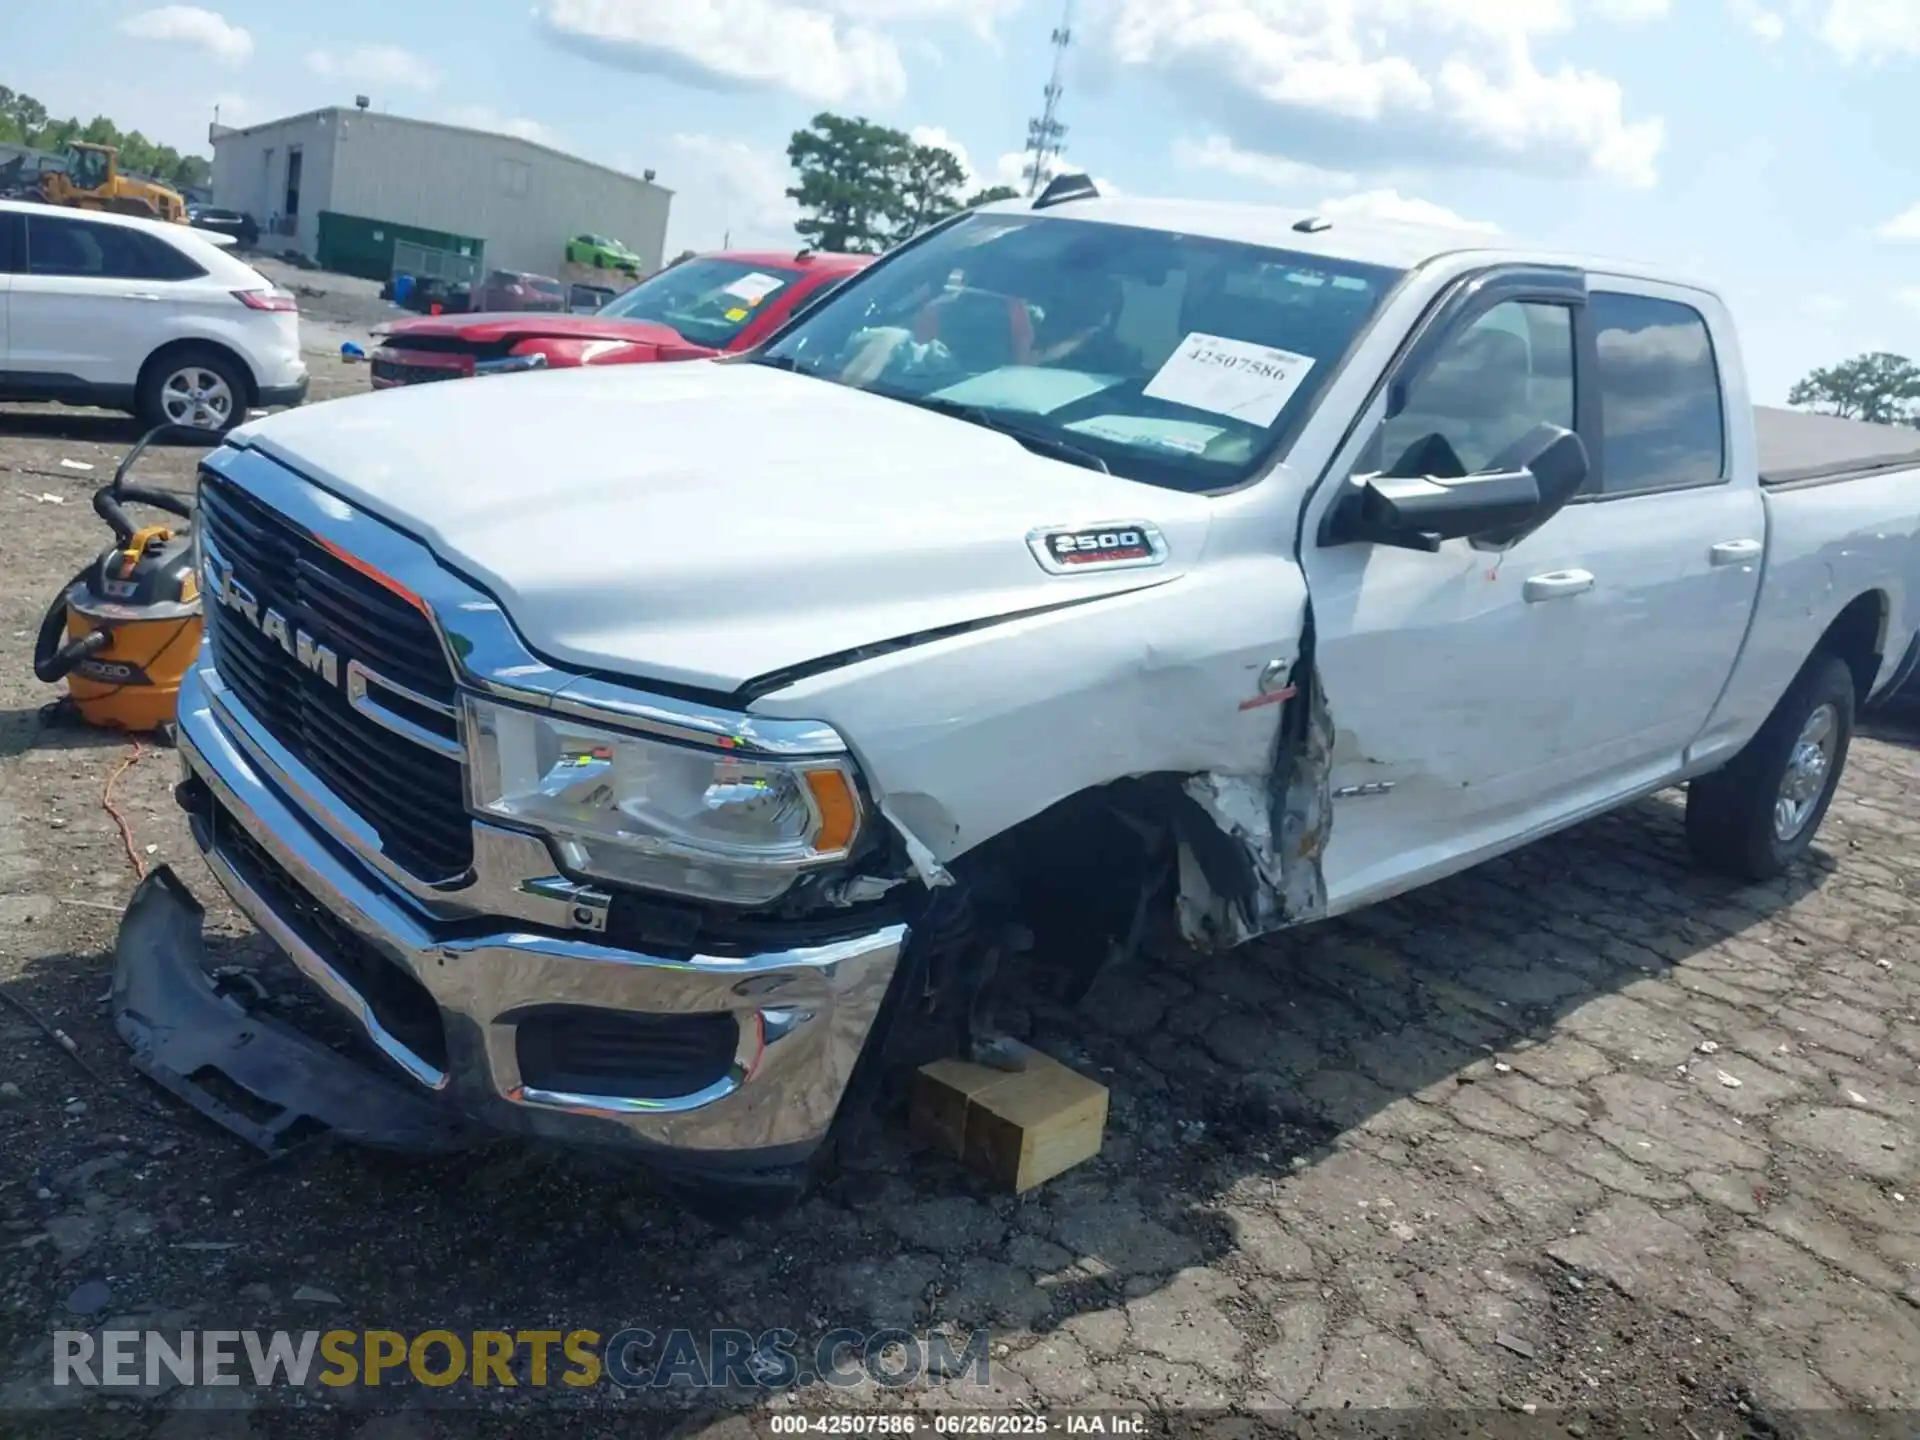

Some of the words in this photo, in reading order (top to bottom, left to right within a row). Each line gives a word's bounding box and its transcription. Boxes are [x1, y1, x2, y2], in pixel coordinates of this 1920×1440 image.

[1186, 348, 1286, 382] 42507586
[1055, 531, 1140, 553] 2500
[228, 577, 338, 689] RAM
